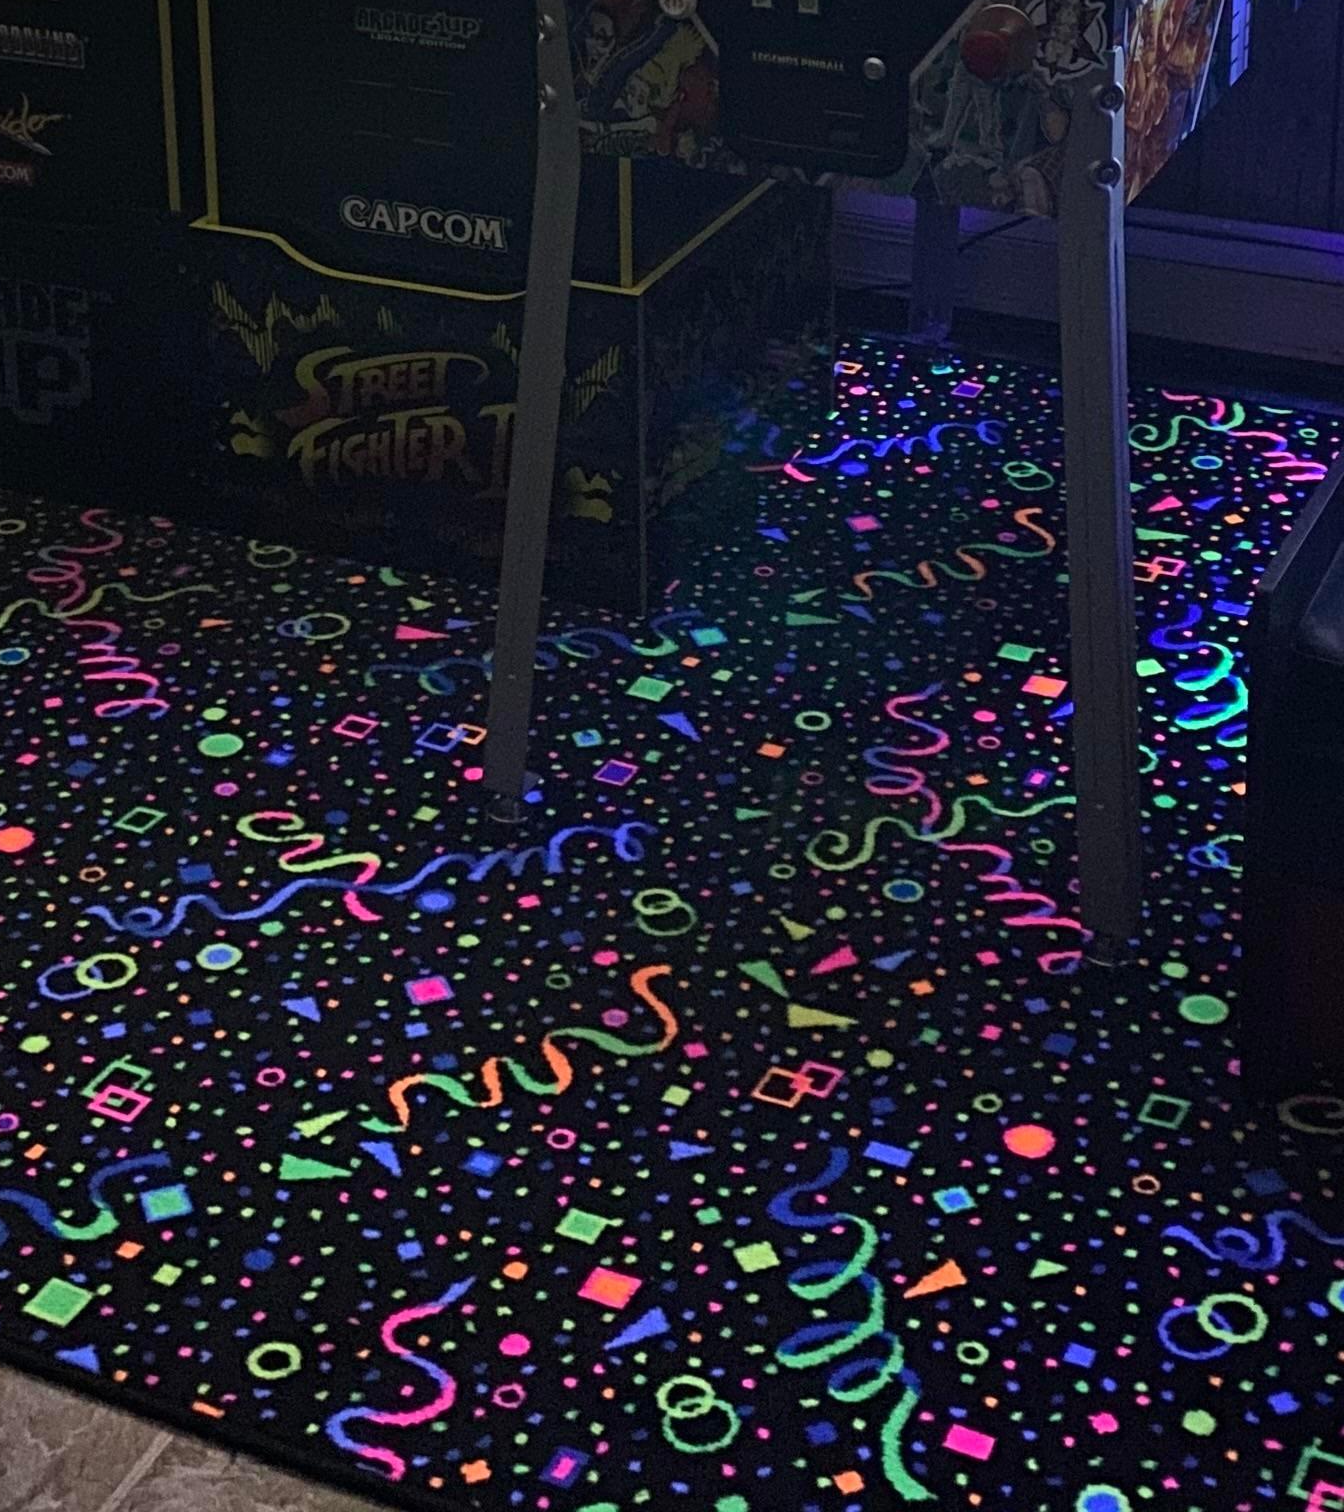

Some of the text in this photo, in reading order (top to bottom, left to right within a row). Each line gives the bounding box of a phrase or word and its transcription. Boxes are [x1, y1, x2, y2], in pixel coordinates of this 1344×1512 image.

[340, 194, 509, 253] CAPCOM
[275, 345, 491, 427] STREET
[287, 405, 484, 487] FIGHTER
